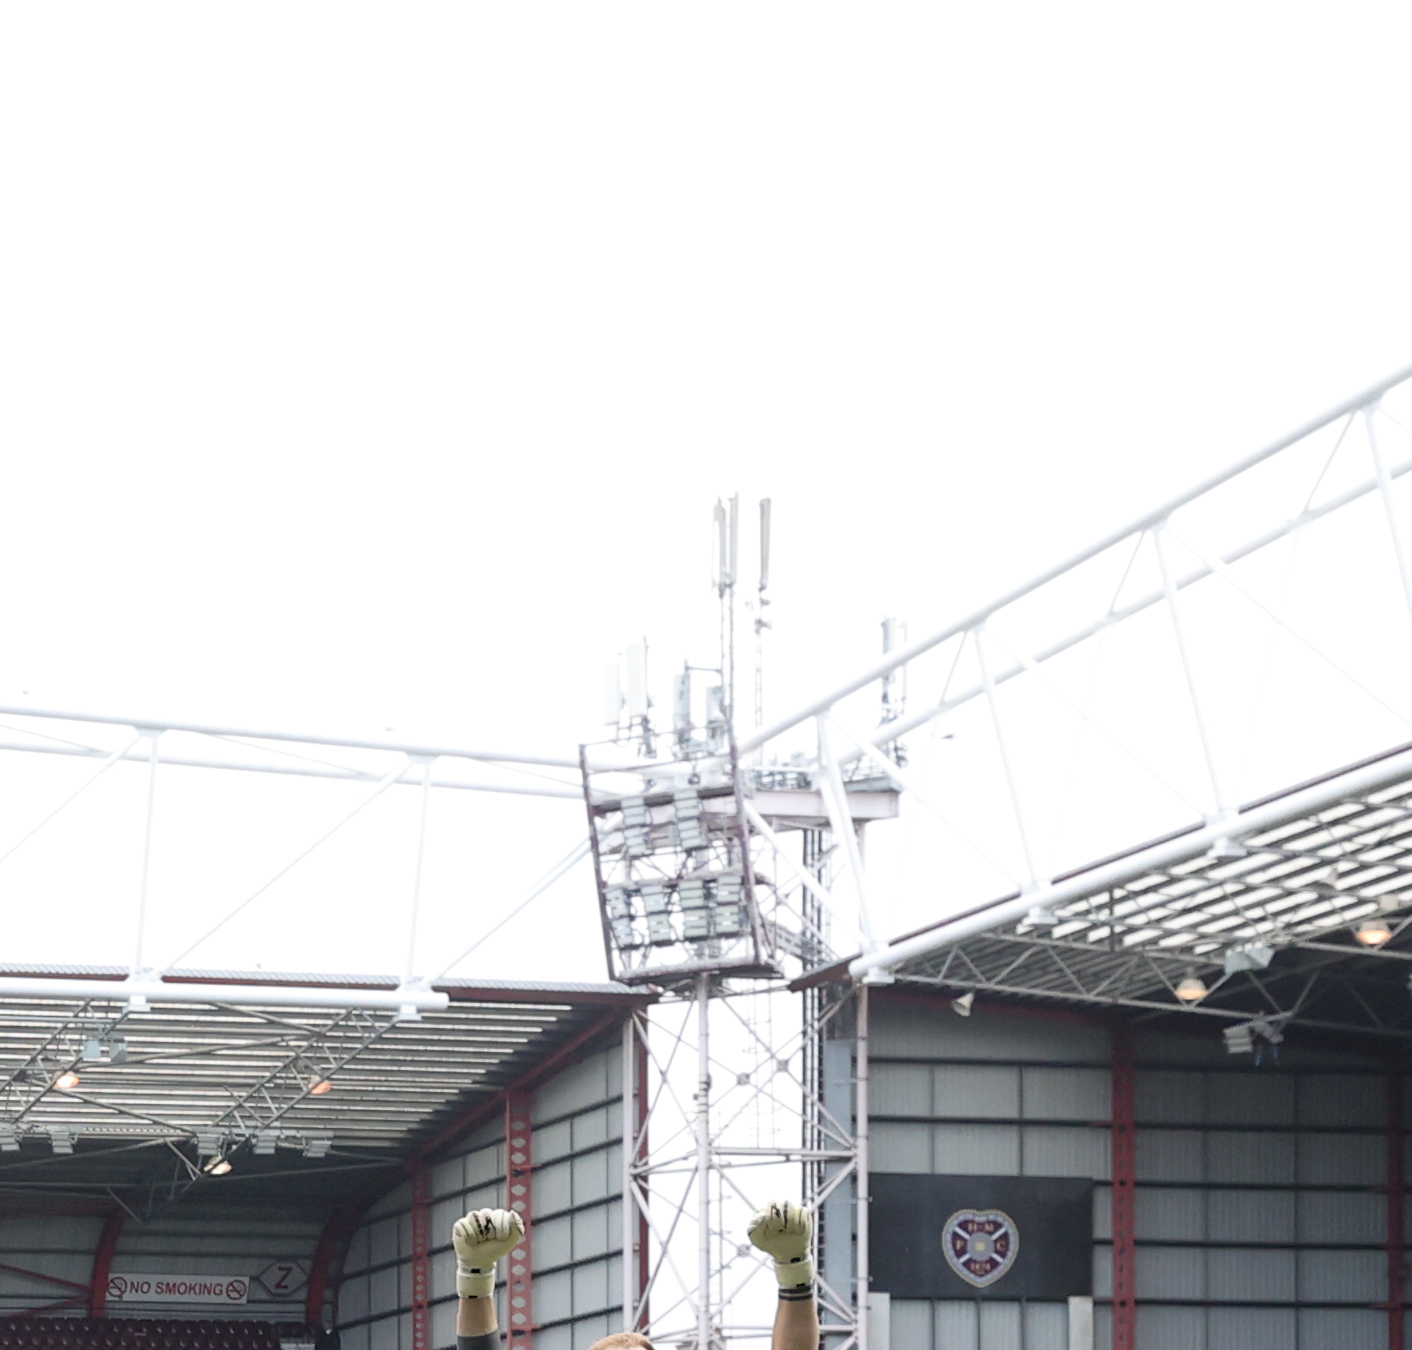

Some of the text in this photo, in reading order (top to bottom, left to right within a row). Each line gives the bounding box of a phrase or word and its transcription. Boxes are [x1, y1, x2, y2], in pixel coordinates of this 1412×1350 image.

[274, 1265, 293, 1289] Z
[129, 1281, 223, 1296] NO SMOKING
